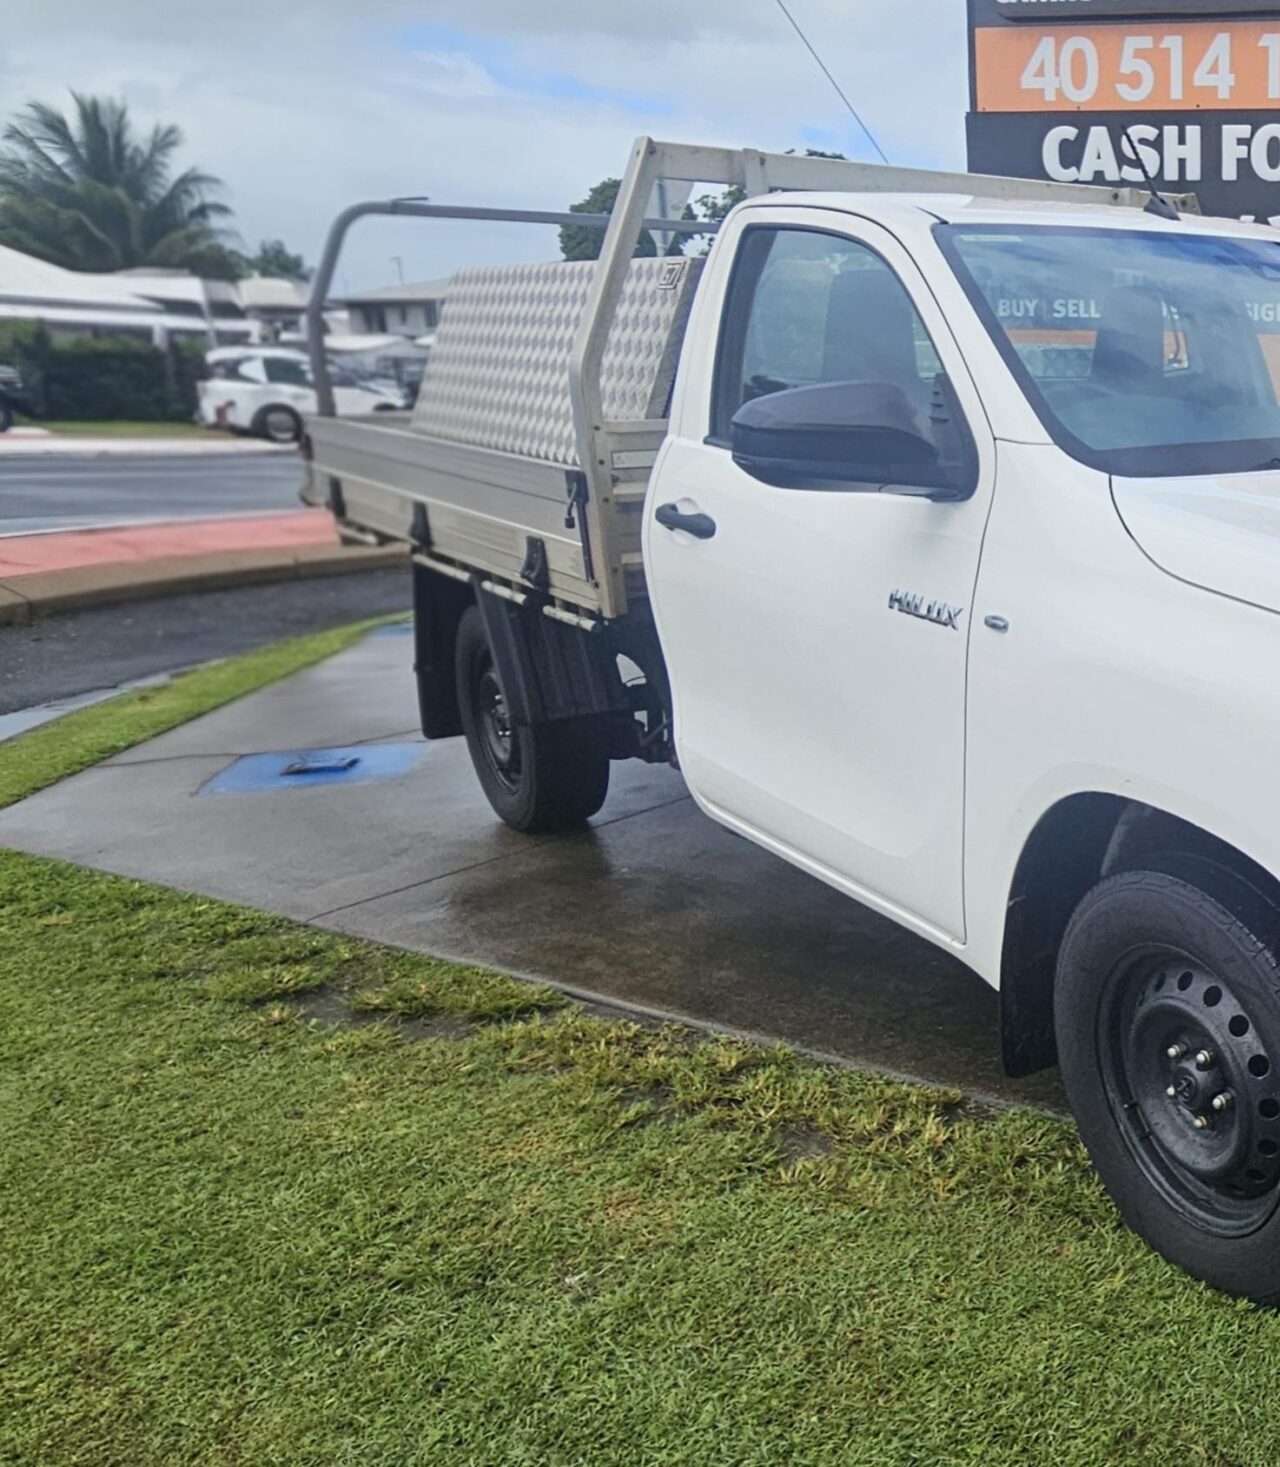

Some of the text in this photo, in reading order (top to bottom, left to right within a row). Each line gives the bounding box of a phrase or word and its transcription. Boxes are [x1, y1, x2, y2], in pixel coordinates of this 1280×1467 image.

[1020, 36, 1099, 102] 40
[1115, 33, 1235, 102] 514
[1041, 124, 1201, 182] CASH
[999, 299, 1101, 318] BUY SELL
[888, 588, 963, 631] HILUX
